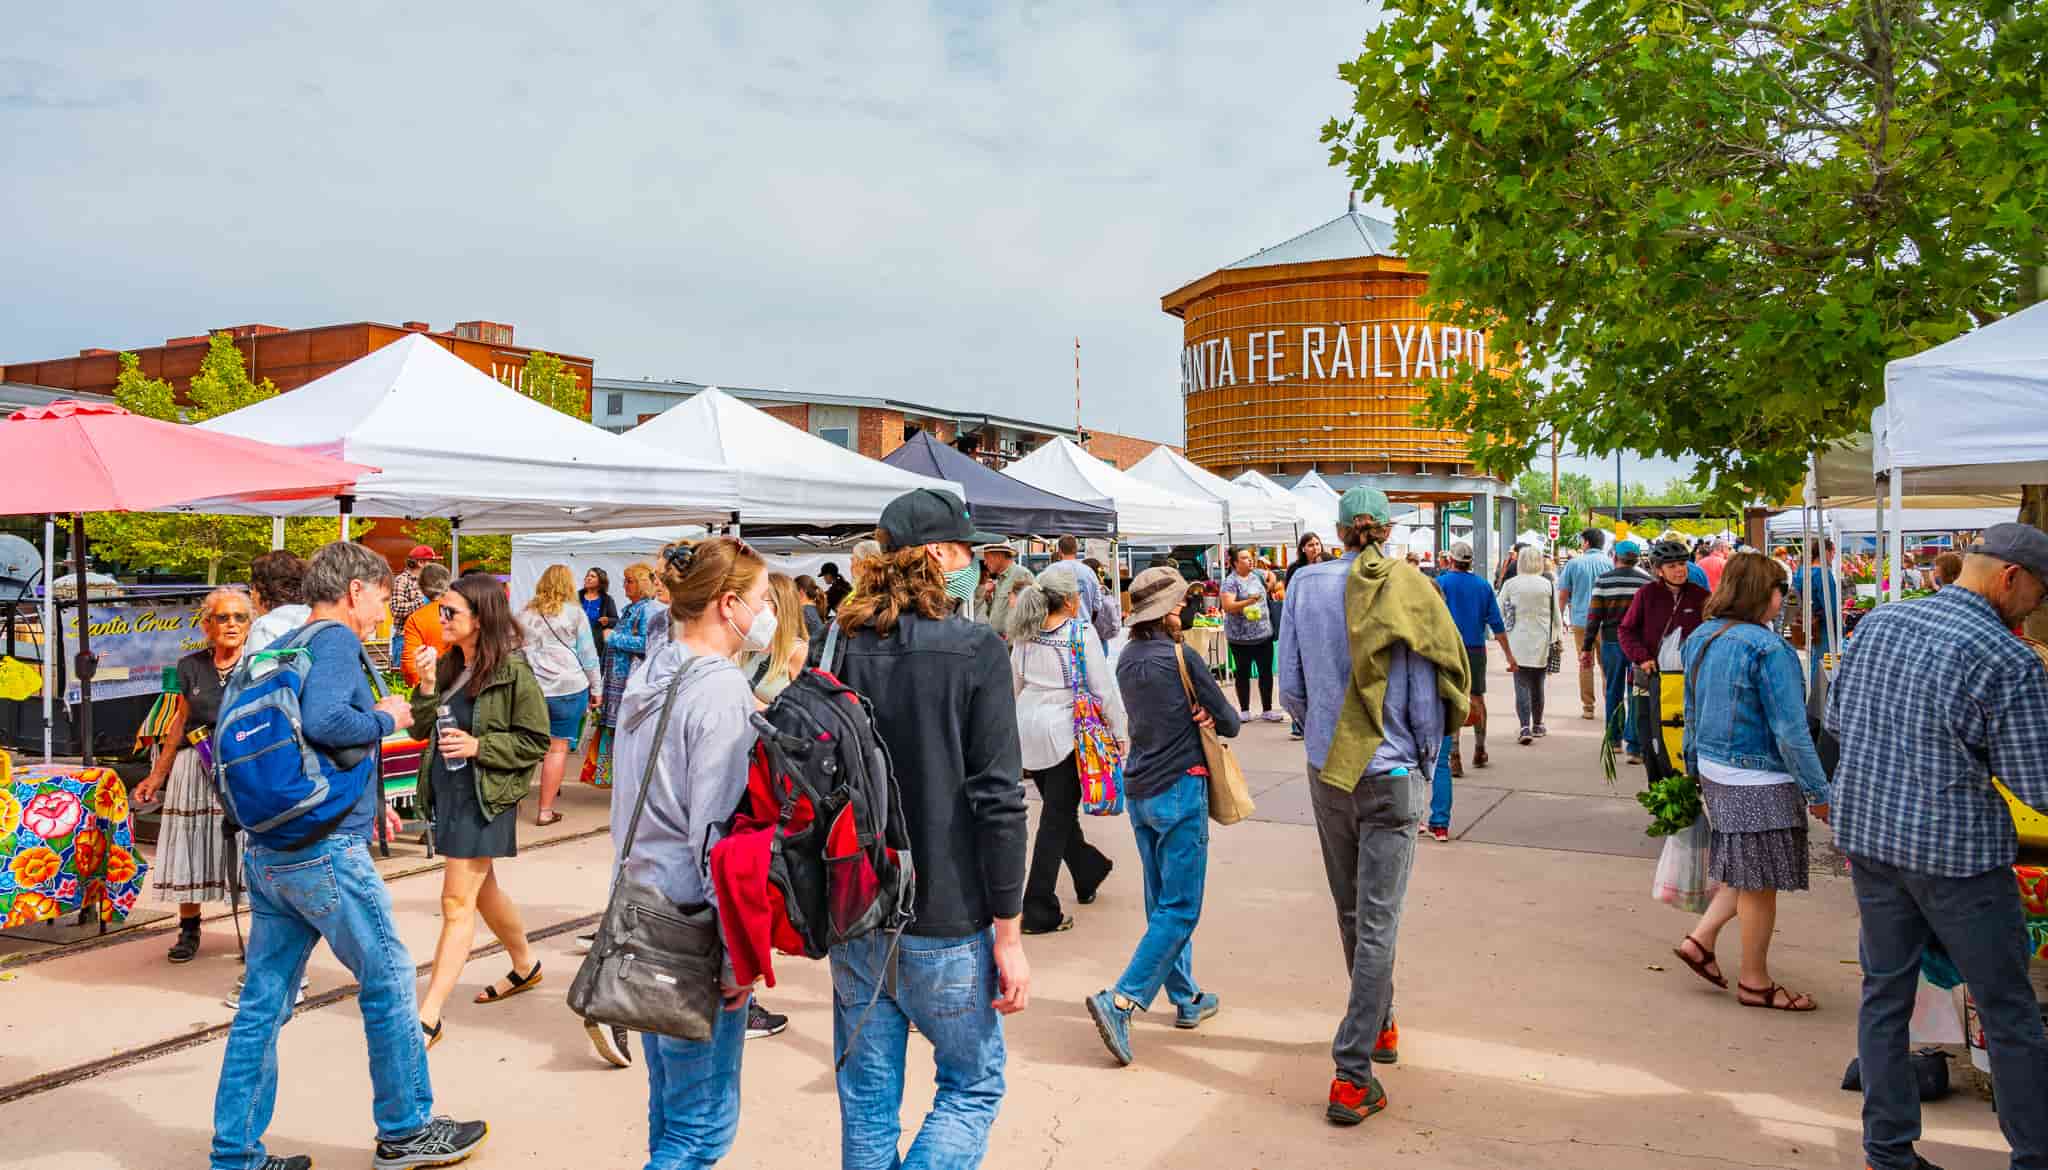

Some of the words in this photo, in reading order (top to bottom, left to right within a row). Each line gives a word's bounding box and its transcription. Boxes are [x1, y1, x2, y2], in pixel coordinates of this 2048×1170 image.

[1248, 330, 1286, 384] FE
[1302, 324, 1485, 379] RAILYARD
[134, 610, 183, 633] Cruz
